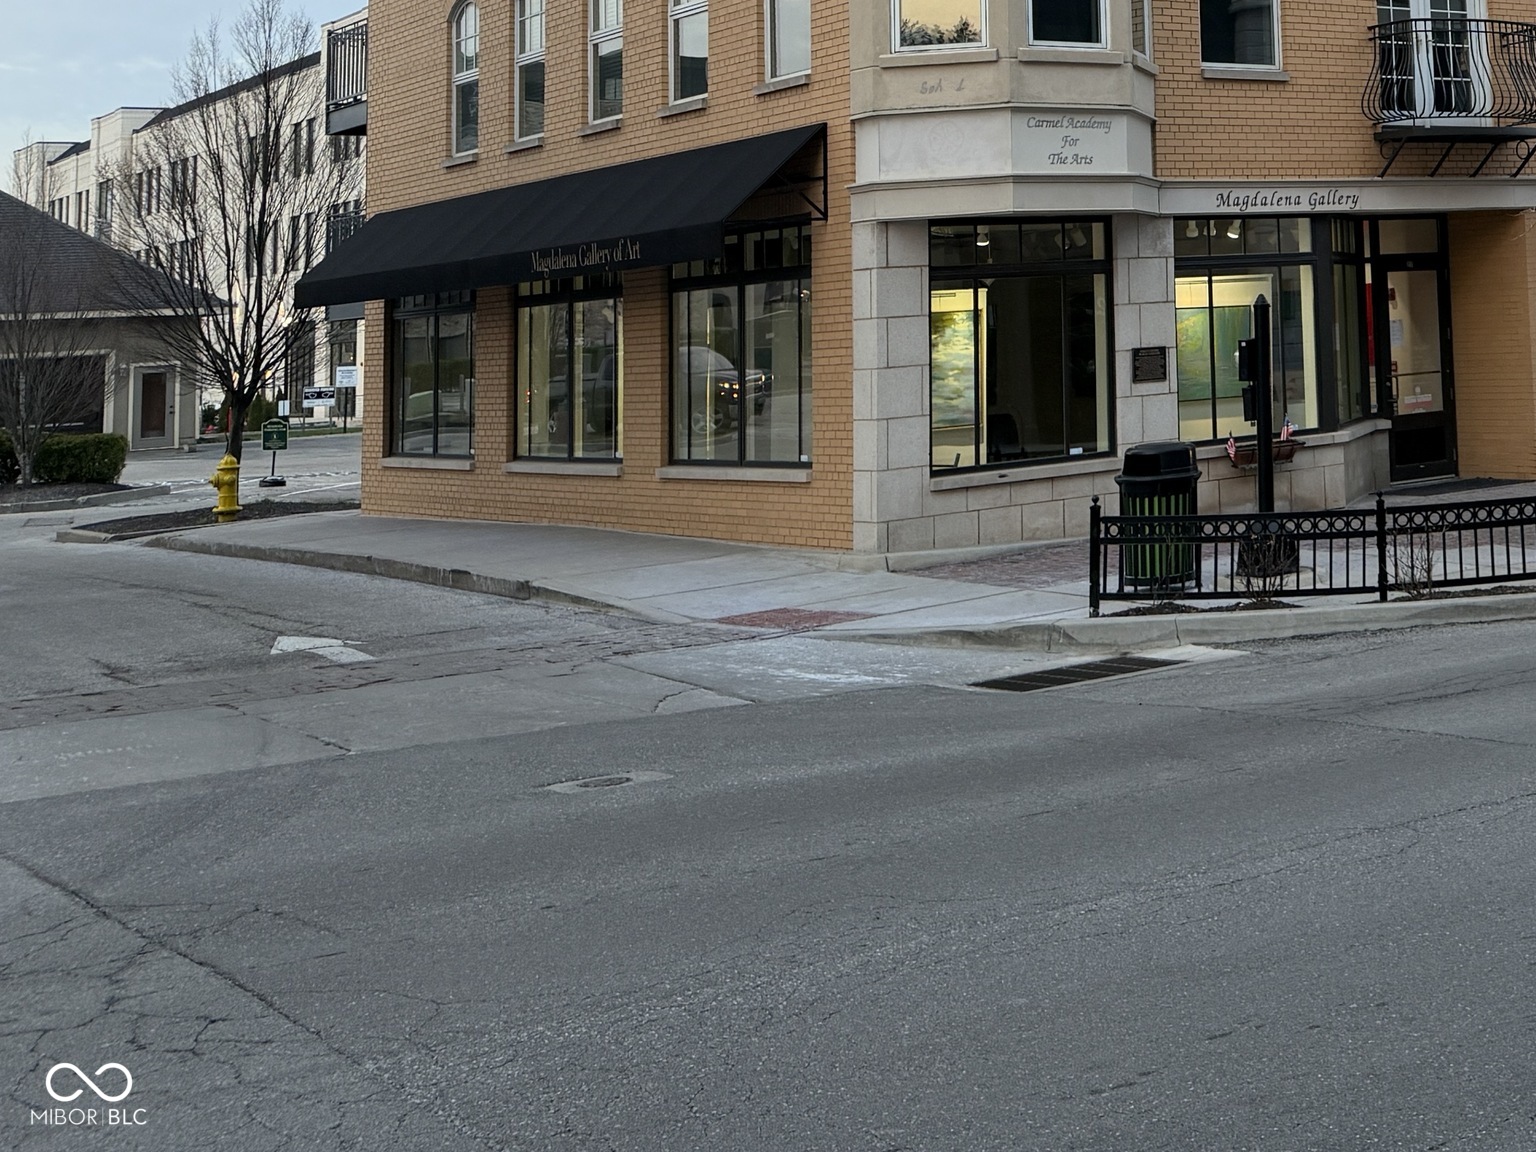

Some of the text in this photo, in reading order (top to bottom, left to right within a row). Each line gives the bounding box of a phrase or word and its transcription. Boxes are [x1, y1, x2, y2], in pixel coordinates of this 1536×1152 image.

[1026, 116, 1112, 134] Carmel Academy
[1061, 135, 1080, 149] For
[1048, 152, 1094, 166] The Arts
[1216, 189, 1360, 212] Magdalena Gallery
[531, 238, 641, 278] Magdalena Gallery of Art
